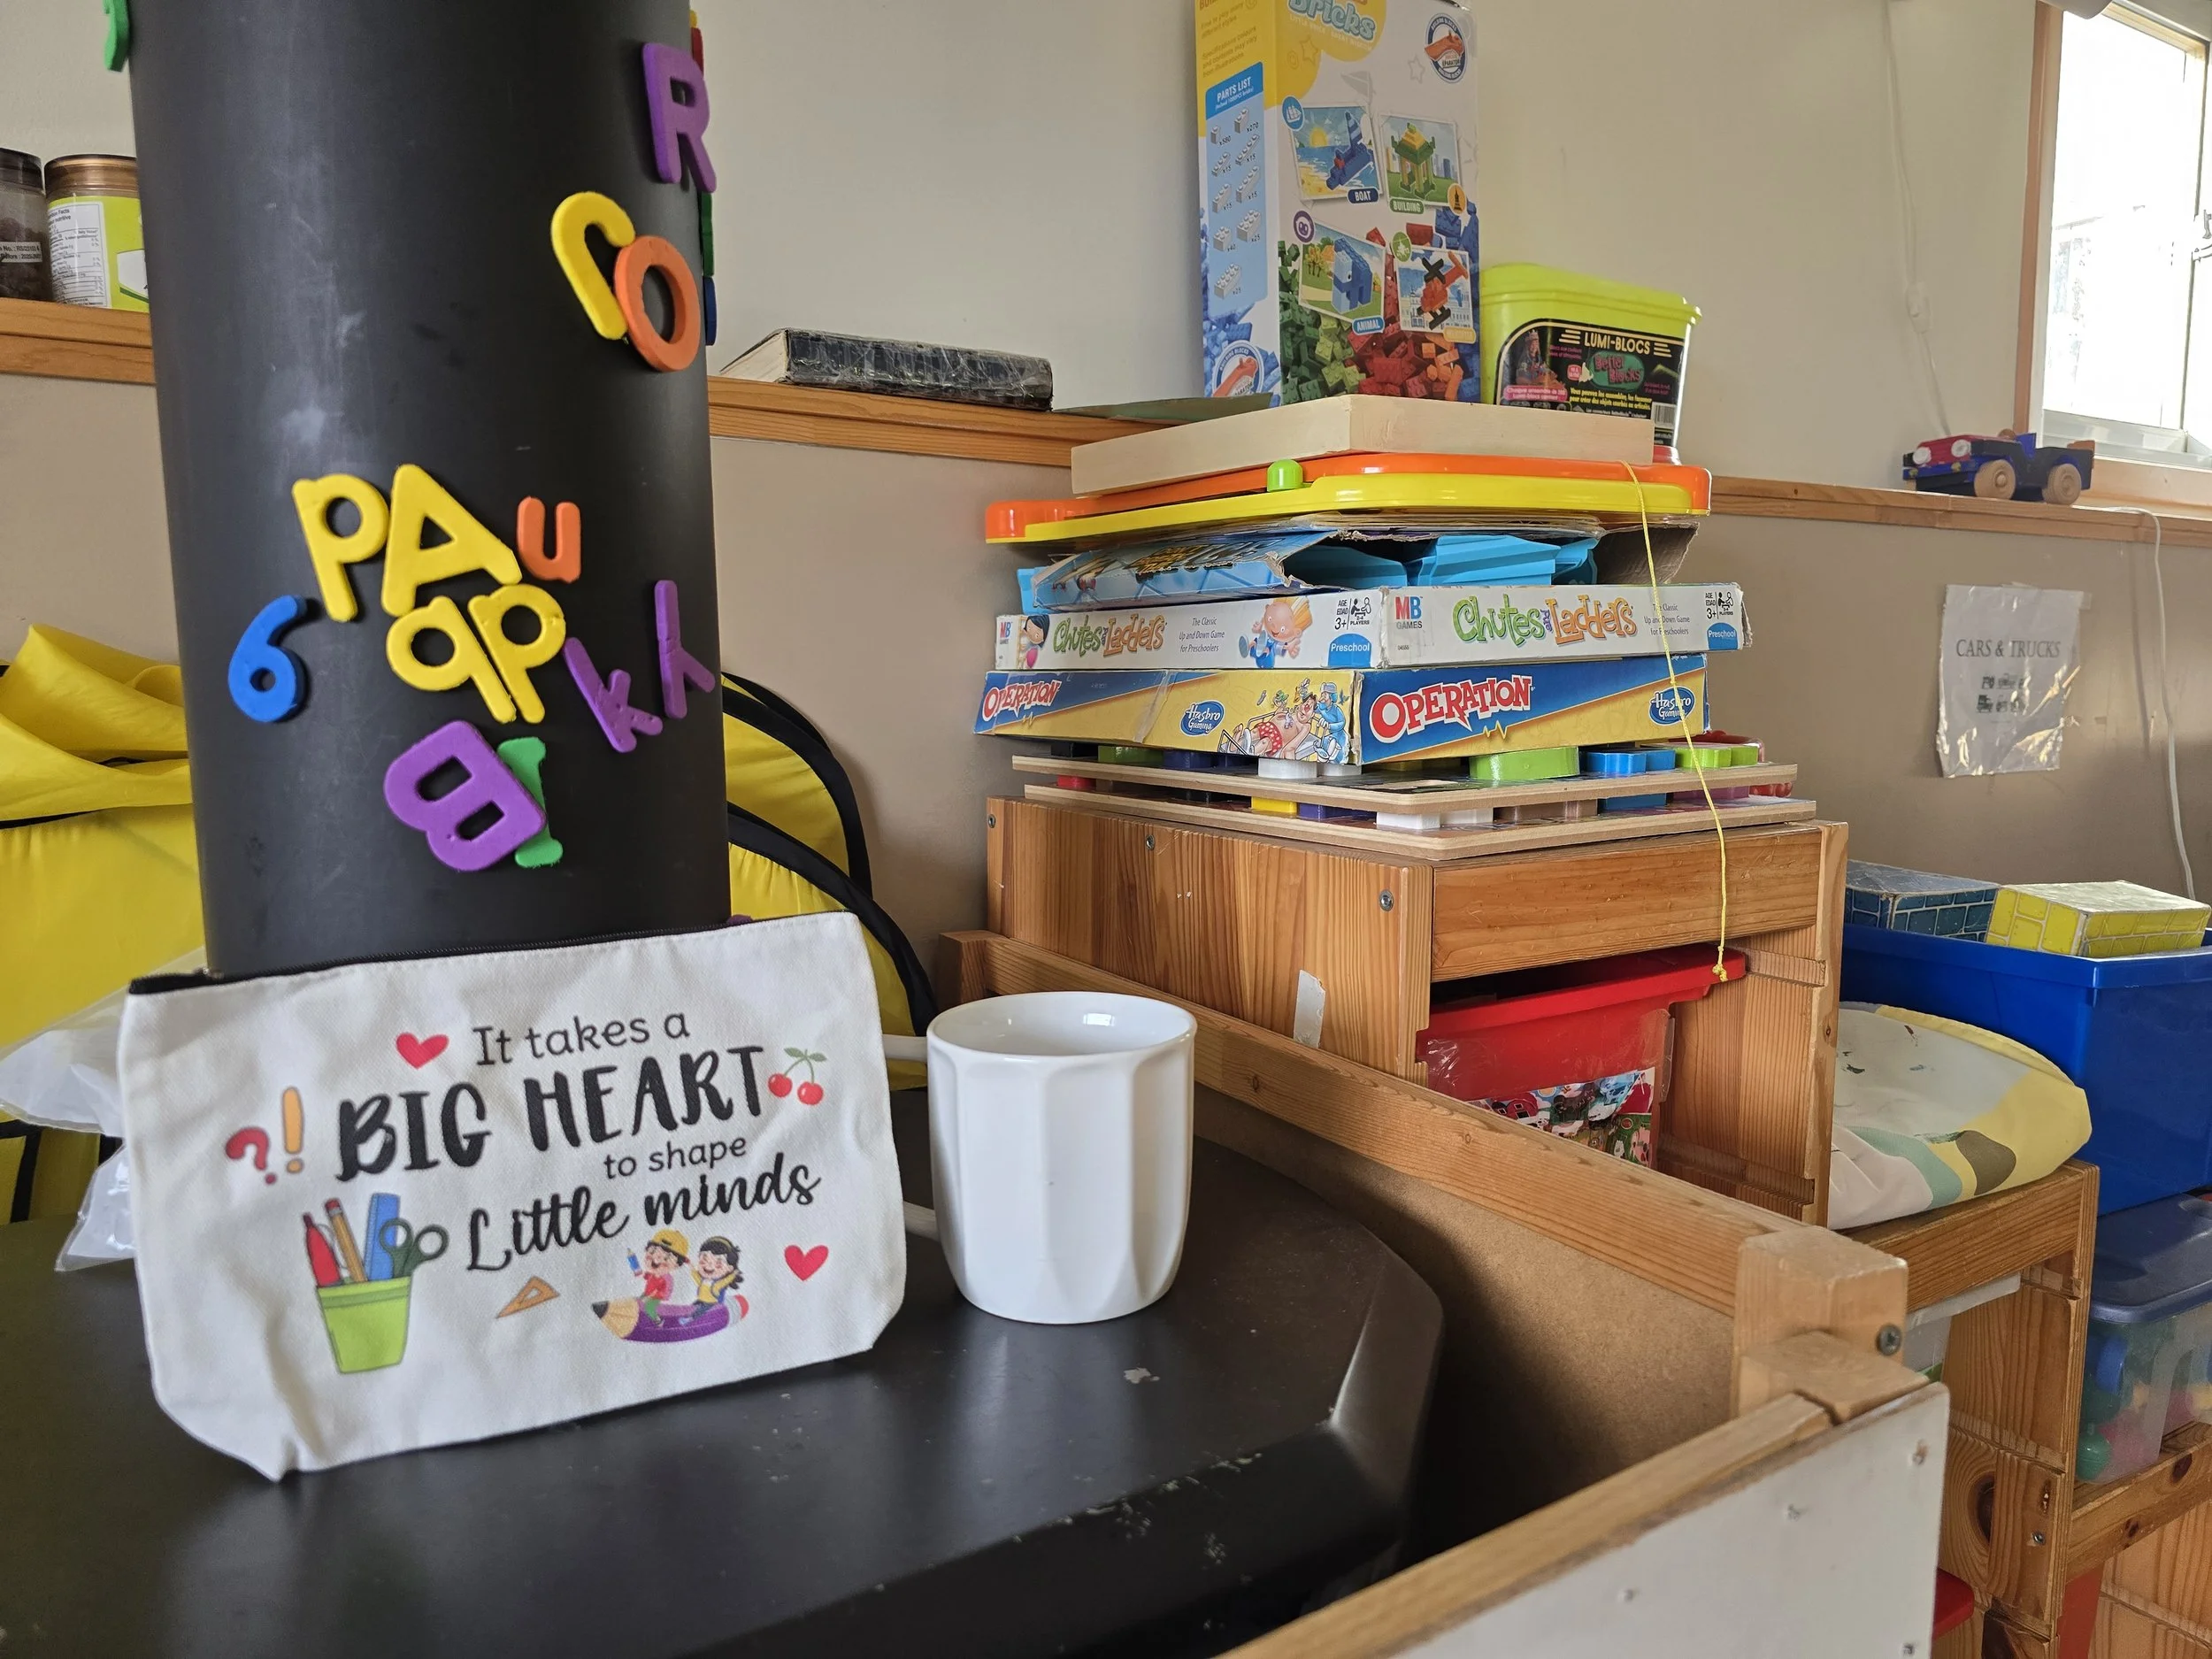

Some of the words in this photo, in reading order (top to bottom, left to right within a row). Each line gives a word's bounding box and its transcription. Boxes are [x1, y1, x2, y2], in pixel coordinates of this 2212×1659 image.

[1217, 84, 1238, 103] PARTS
[1238, 77, 1252, 93] LIST
[1355, 191, 1371, 202] BOAT
[1394, 201, 1421, 212] BUILDING
[1356, 319, 1380, 332] ANIMAL
[1584, 332, 1651, 355] LUMI-BLOCS
[1394, 595, 1421, 620] MB
[1707, 608, 1717, 619] 3+
[1192, 618, 1201, 626] The
[1202, 617, 1217, 626] Classic
[1334, 618, 1347, 630] 3+
[1396, 620, 1422, 630] GAMES
[1452, 594, 1547, 647] Chutes
[1545, 595, 1637, 647] Ladders
[1644, 616, 1651, 625] Up
[1662, 615, 1676, 624] Down
[1677, 615, 1690, 624] Game
[1000, 622, 1012, 638] MB
[1053, 615, 1102, 657] Chutes
[1102, 613, 1166, 657] Ladders
[1179, 632, 1186, 641] Up
[1187, 631, 1195, 640] and
[1197, 631, 1209, 640] Down
[1210, 630, 1225, 640] Game
[1708, 629, 1735, 638] Preschool
[1188, 643, 1219, 653] Preschoolers
[1331, 642, 1371, 653] Preschool
[1955, 639, 1991, 657] CARS
[1995, 640, 2005, 657] &
[2009, 640, 2061, 658] TRUCKS
[982, 680, 1062, 721] OPERATION
[1187, 704, 1220, 720] Hasbro
[1370, 675, 1532, 743] OPERATION
[1188, 718, 1213, 732] Gaming
[472, 1025, 512, 1067] It
[524, 1016, 651, 1060] takes
[664, 1011, 690, 1040] a
[335, 1081, 493, 1183] BIG
[523, 1046, 765, 1152] HEART
[604, 1152, 636, 1180] to
[649, 1134, 748, 1173] shape
[466, 1186, 630, 1273] Little
[645, 1152, 822, 1228] minds
